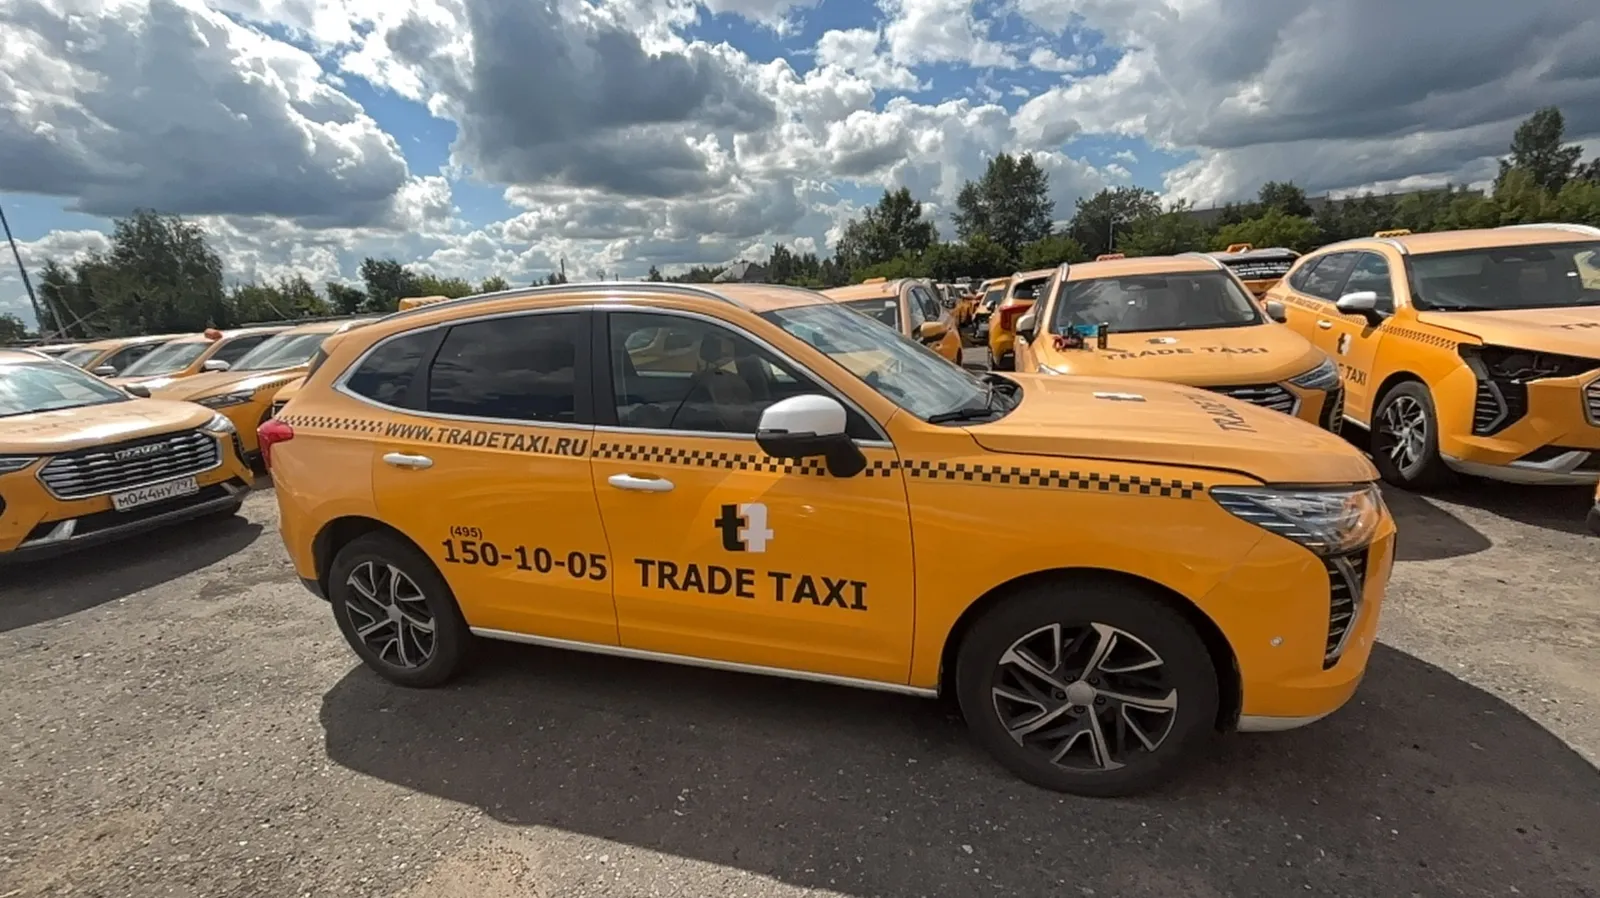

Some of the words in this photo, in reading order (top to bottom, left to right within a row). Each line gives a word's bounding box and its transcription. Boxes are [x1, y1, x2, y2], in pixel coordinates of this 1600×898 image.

[1102, 348, 1195, 360] TRADE
[1345, 364, 1367, 386] TAXI
[385, 421, 588, 457] WWW.TRADETAXI.RU
[449, 526, 483, 540] (495)
[442, 539, 608, 582] 150-10-05
[634, 558, 756, 599] TRADE
[767, 570, 868, 611] TAXI
